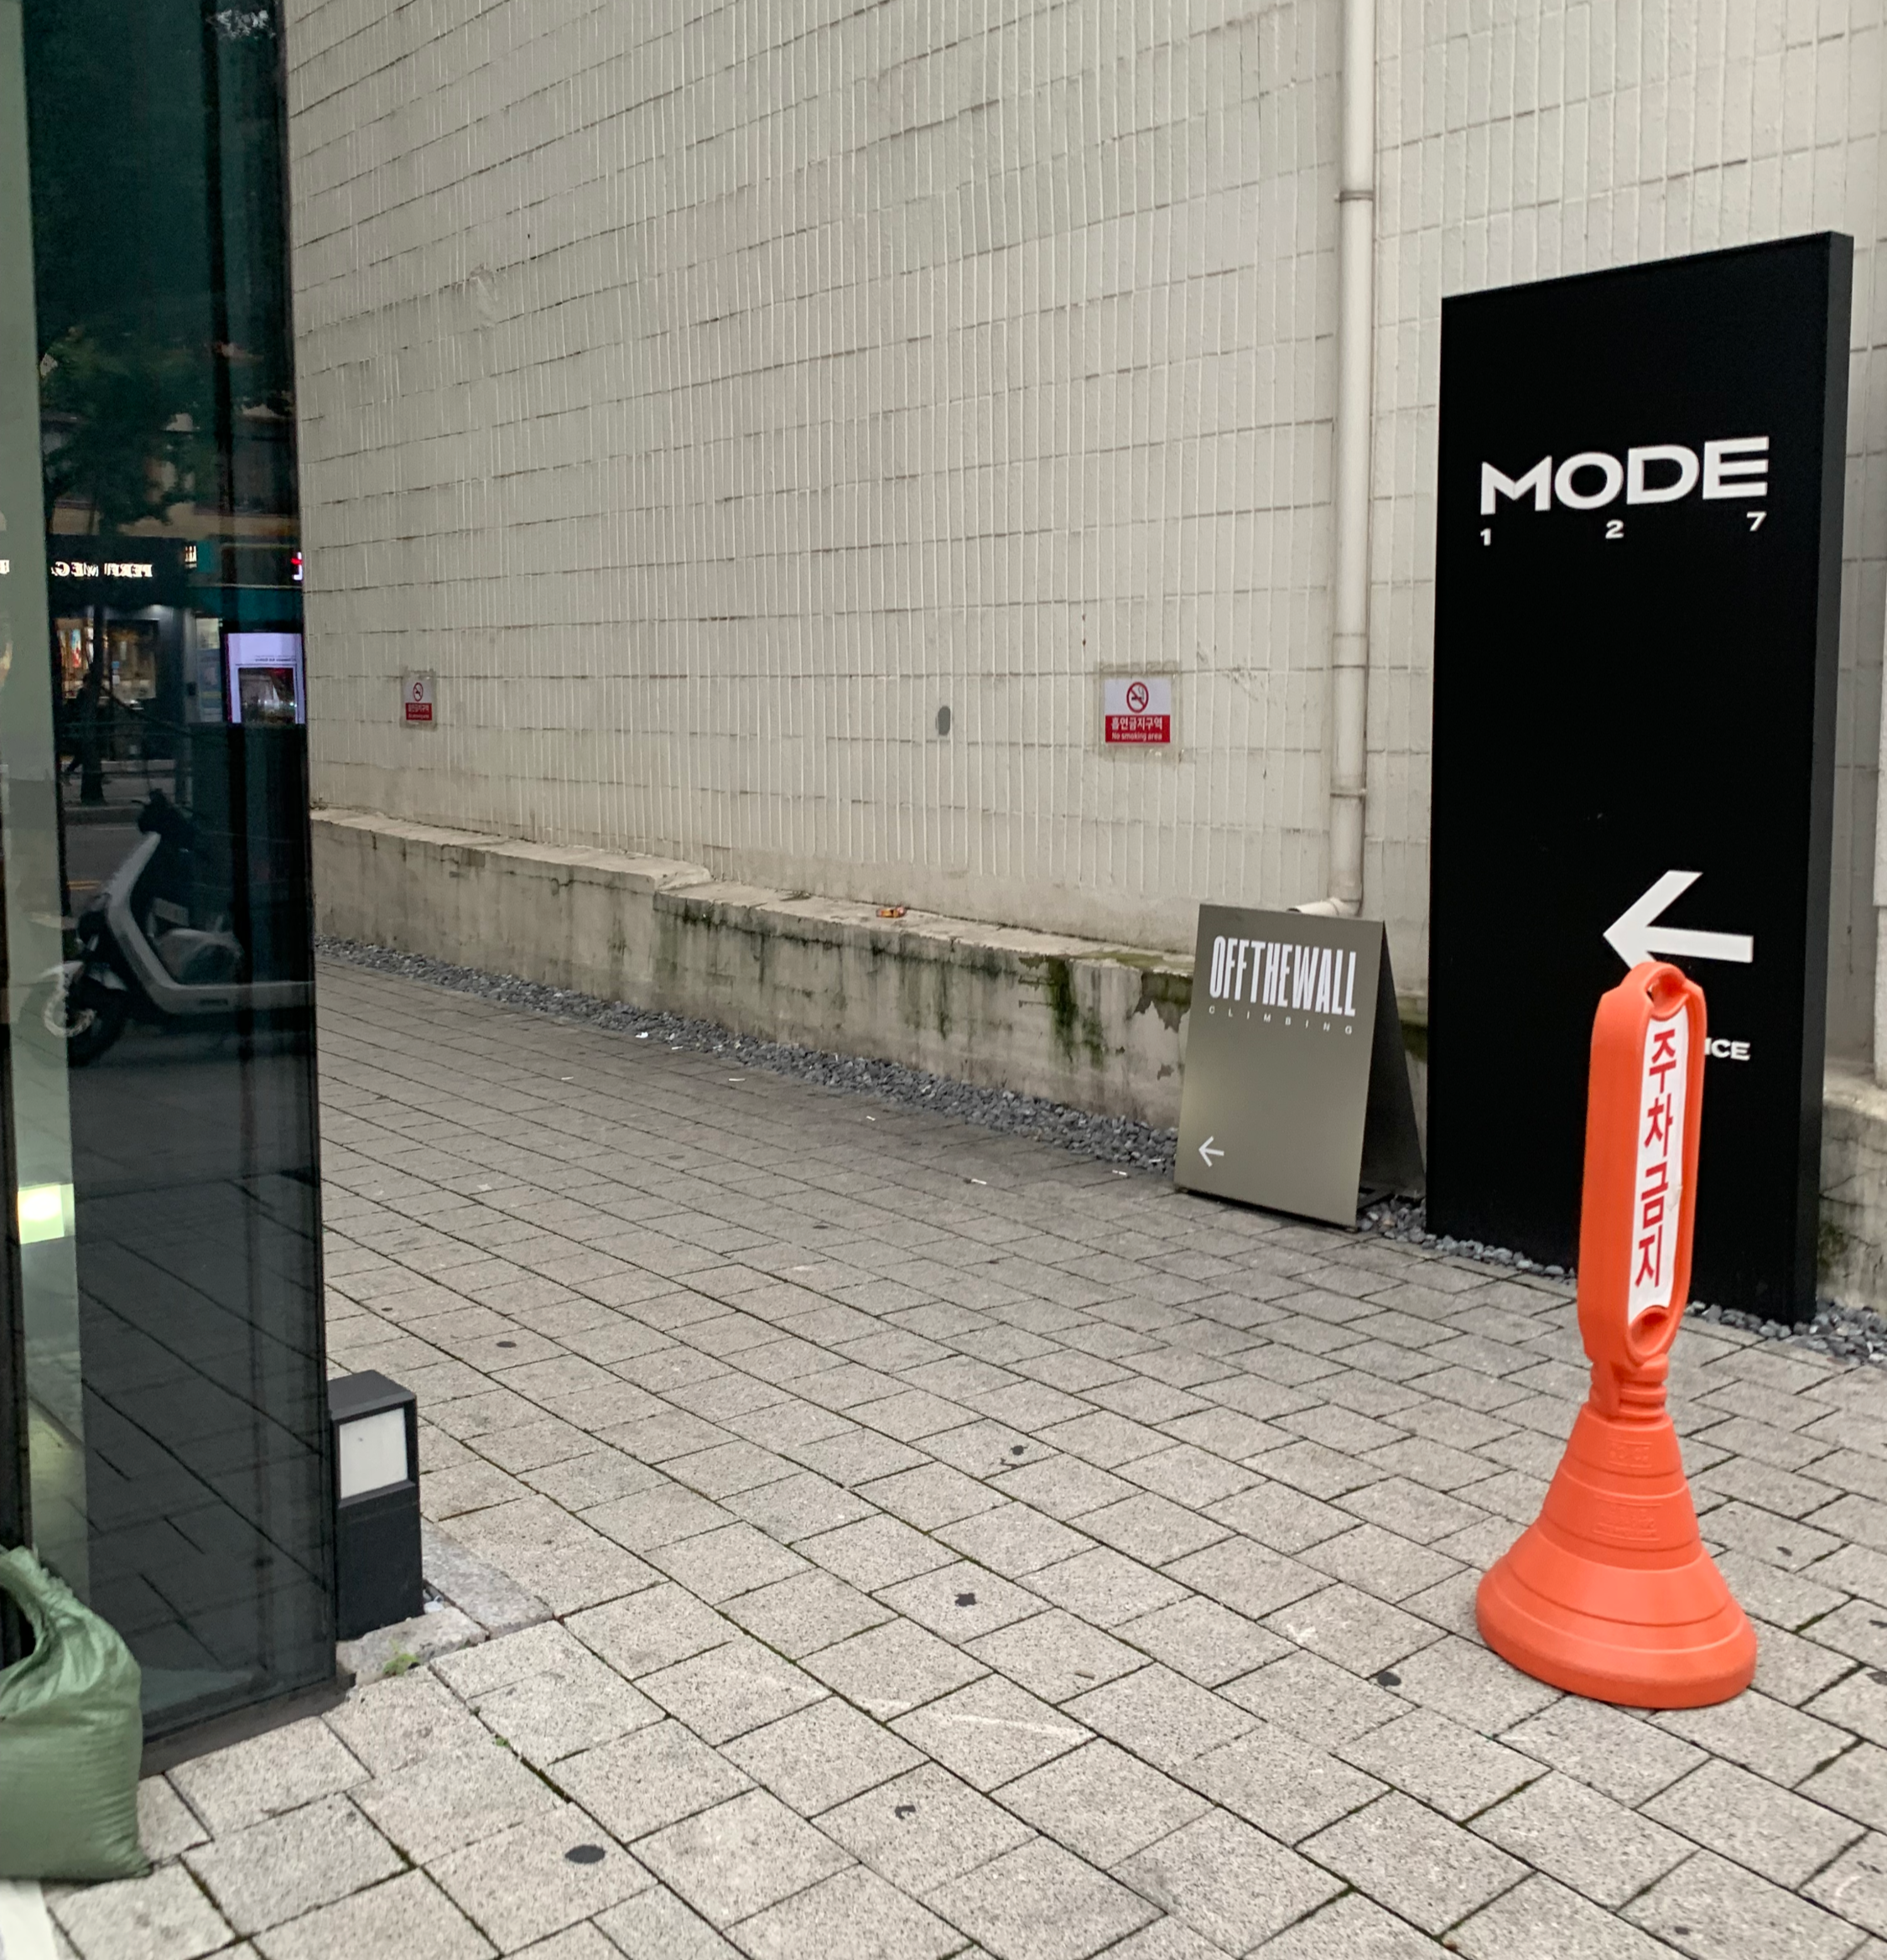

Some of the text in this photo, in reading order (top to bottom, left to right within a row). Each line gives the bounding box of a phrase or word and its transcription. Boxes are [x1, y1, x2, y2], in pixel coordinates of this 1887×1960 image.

[1480, 435, 1770, 516] MODE
[1479, 511, 1767, 547] 1 2 7
[1111, 716, 1163, 730] 흡연금지구역
[1121, 732, 1147, 742] smoking
[1209, 935, 1357, 1017] OFFTHEWALL
[1209, 1006, 1353, 1035] CLIMBING
[1704, 1037, 1751, 1061] ICE
[1635, 1029, 1676, 1288] 주차금지
